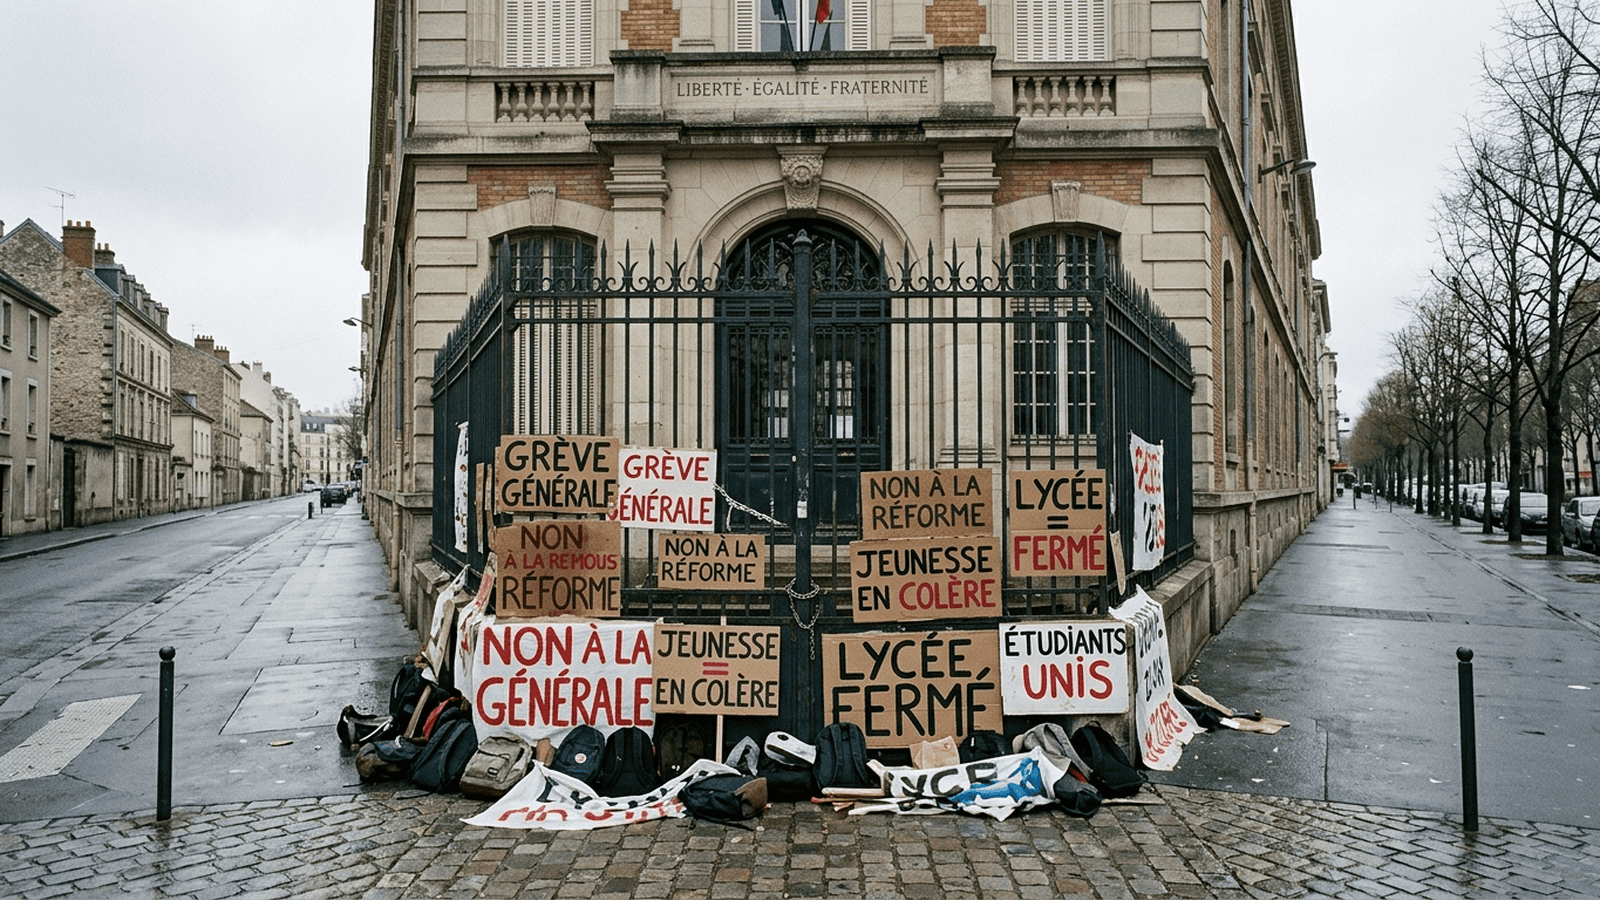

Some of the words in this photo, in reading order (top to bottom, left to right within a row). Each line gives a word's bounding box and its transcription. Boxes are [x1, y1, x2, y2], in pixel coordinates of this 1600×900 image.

[677, 77, 742, 97] LIBERTÉ
[753, 77, 819, 97] ÉGALITÉ
[830, 76, 929, 95] FRATERNITÉ
[504, 436, 611, 472] GRÈVE
[623, 448, 709, 481] GRÈVE
[870, 475, 920, 499] NON
[929, 469, 945, 497] À
[953, 474, 982, 496] LA
[1015, 469, 1103, 510] LYCÉE
[607, 487, 713, 525] ÉNÉRALE
[872, 500, 986, 530] RÉFORME
[521, 524, 583, 550] NON
[665, 537, 710, 557] NON
[715, 534, 730, 557] À
[735, 540, 758, 558] LA
[1014, 524, 1105, 571] FERMÉ
[503, 549, 518, 569] À
[522, 553, 545, 569] LA
[662, 557, 756, 583] RÉFORME
[856, 545, 993, 578] JEUNESSE
[502, 570, 621, 611] RÉFORME
[858, 585, 891, 611] EN
[898, 575, 996, 611] COLÈRE
[483, 625, 573, 666] NON
[581, 622, 607, 664] À
[615, 629, 652, 665] LA
[657, 630, 779, 660] JEUNESSE
[838, 631, 972, 681] LYCÉE
[476, 667, 654, 727] GÉNÉRALE
[655, 678, 685, 705] EN
[691, 672, 778, 708] COLÈRE
[832, 666, 995, 738] FERMÉ
